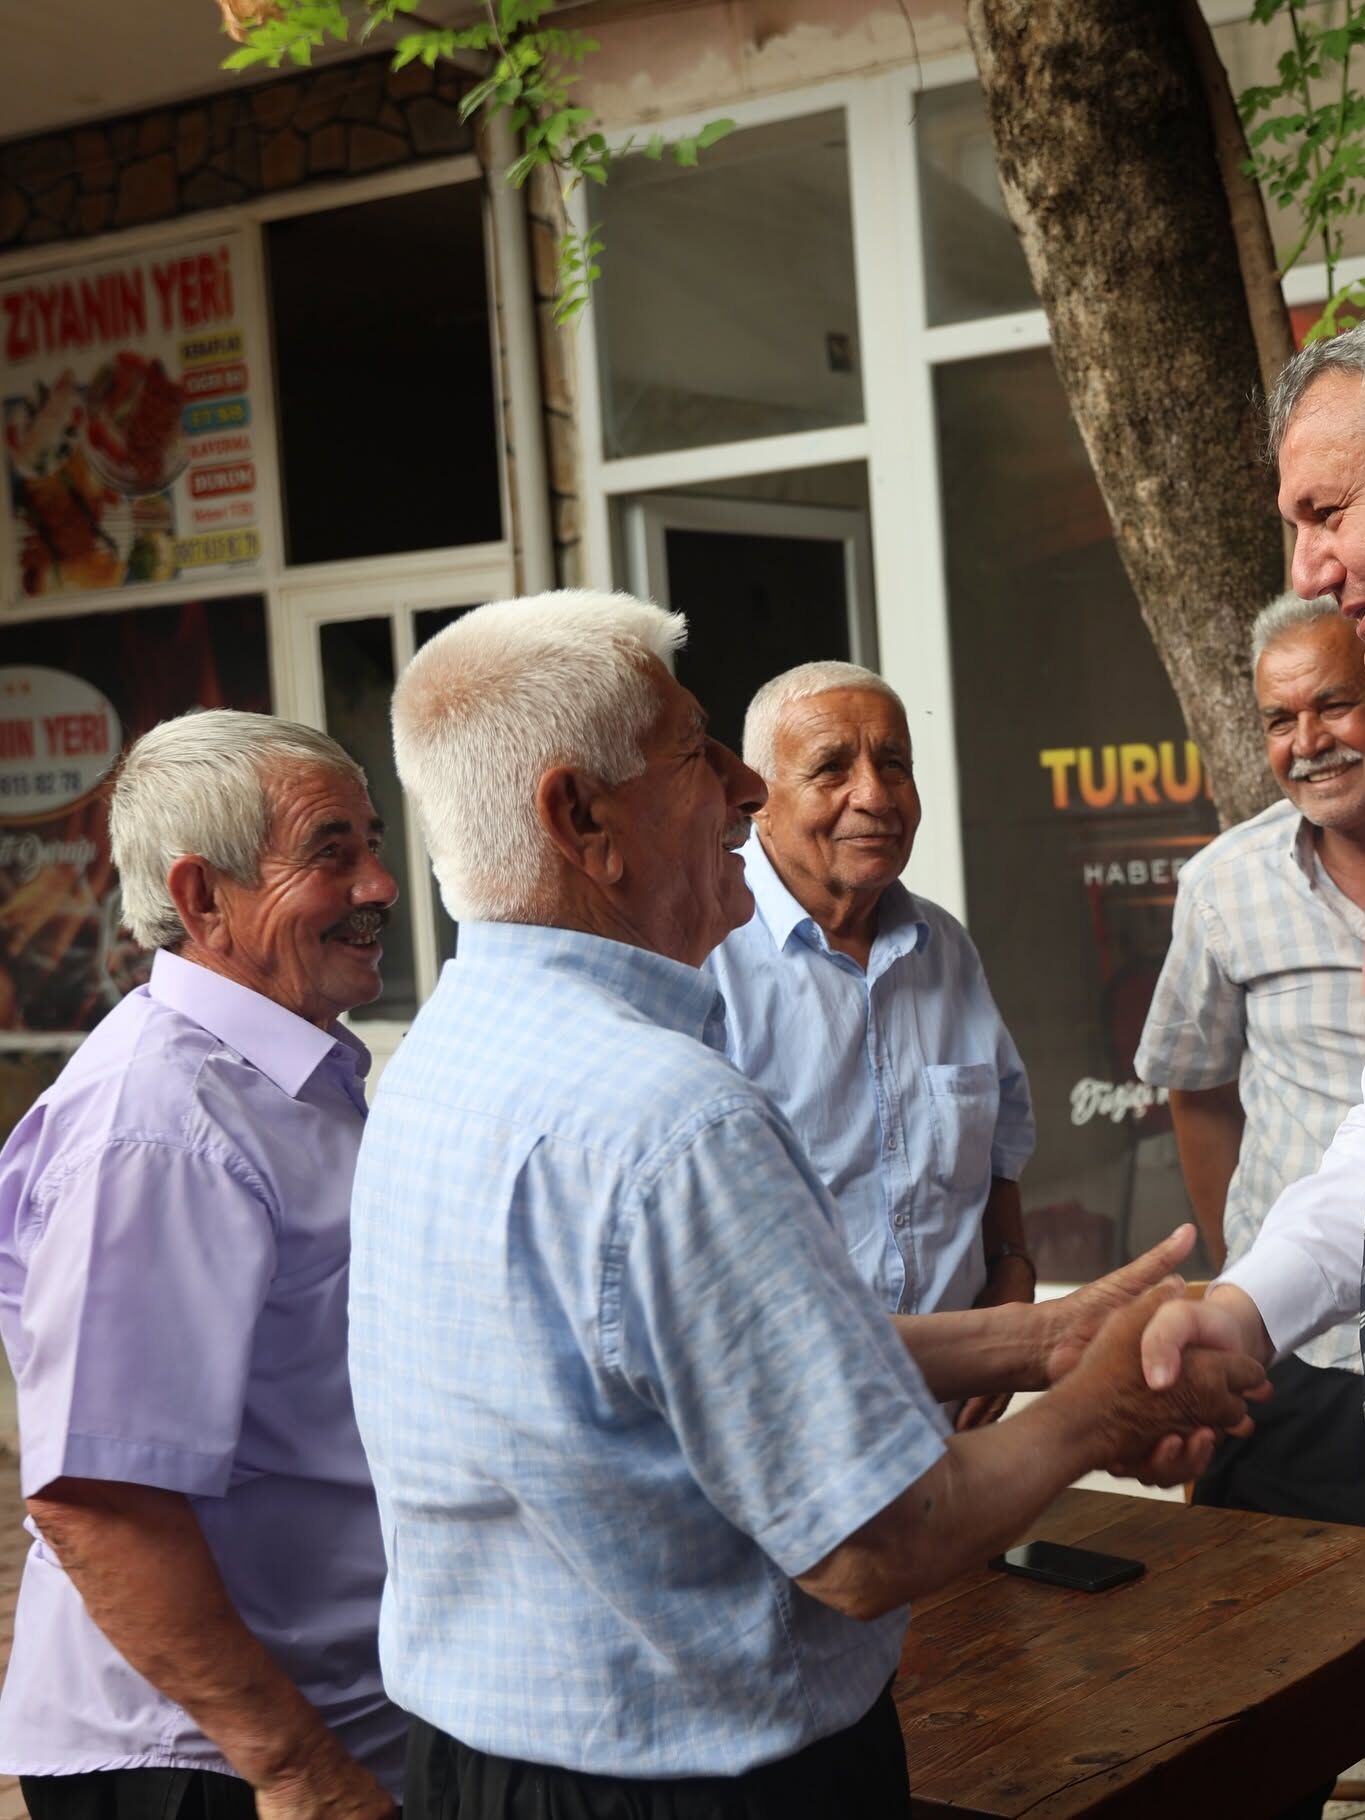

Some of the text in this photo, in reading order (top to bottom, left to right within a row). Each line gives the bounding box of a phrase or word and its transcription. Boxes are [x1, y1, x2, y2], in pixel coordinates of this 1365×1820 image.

[151, 245, 235, 331] YERİ
[44, 703, 109, 757] YERİ
[1040, 740, 1213, 810] TURU
